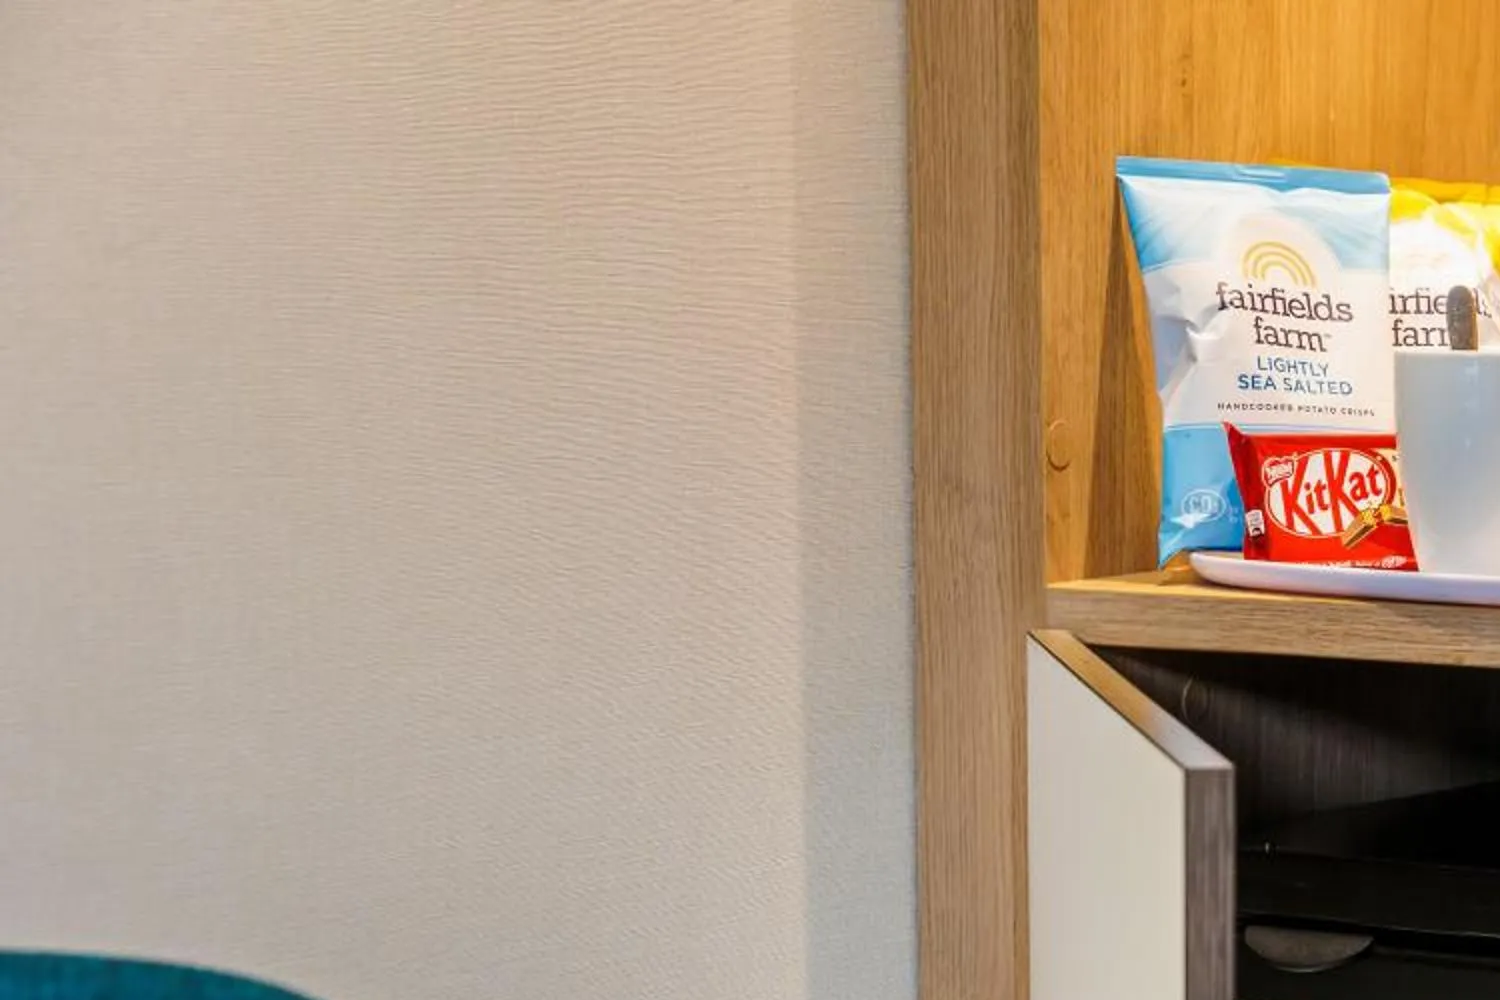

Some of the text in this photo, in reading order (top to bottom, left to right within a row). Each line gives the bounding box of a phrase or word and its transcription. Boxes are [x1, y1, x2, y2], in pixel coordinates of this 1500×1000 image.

[1215, 281, 1354, 323] fairfields
[1252, 315, 1328, 353] farm
[1237, 373, 1353, 396] SEA SALTED
[1217, 402, 1375, 417] HANDCOOKED POTATO CRISPS
[1279, 450, 1382, 536] KitKat
